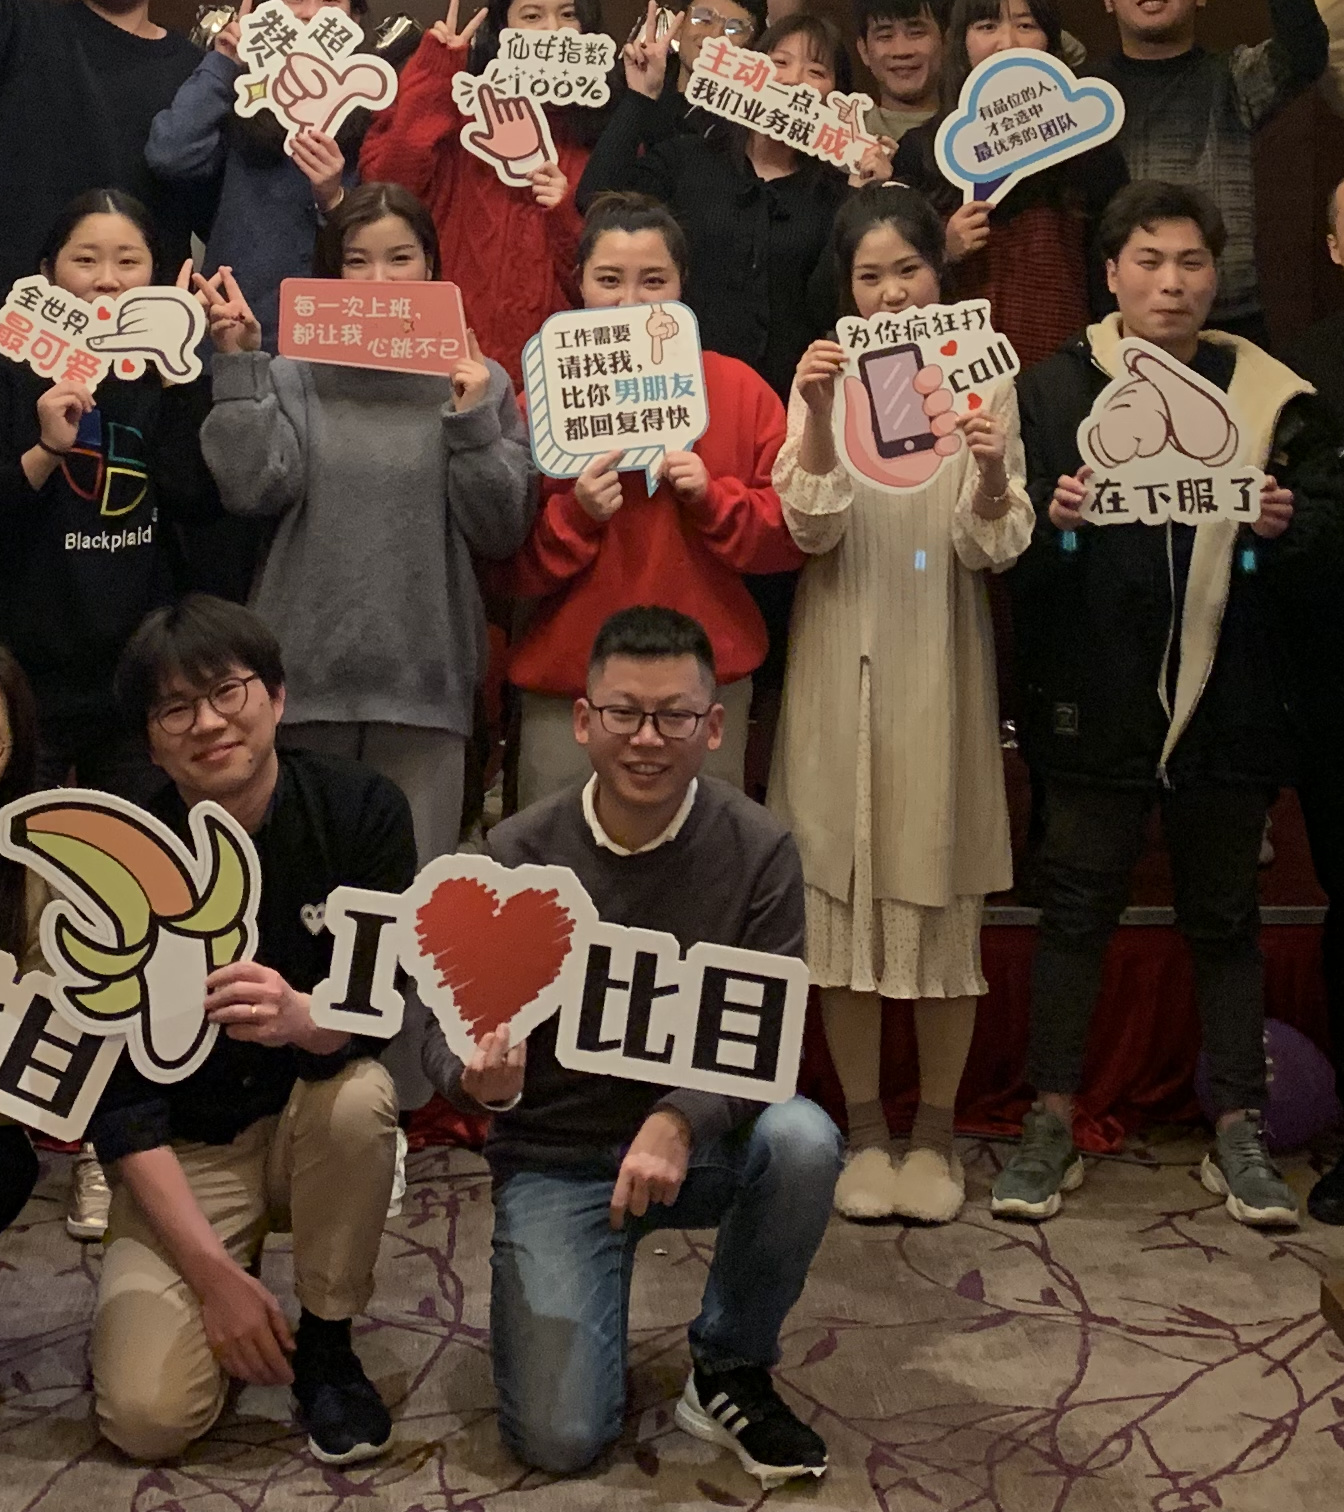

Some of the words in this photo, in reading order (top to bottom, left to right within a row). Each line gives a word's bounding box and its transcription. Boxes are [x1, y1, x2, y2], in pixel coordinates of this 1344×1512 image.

[507, 33, 609, 65] 仙女指数
[515, 73, 603, 100] 100%
[973, 112, 1078, 163] 最优秀的团队
[984, 103, 1044, 137] 才会选中
[14, 286, 89, 336] 全世界
[847, 306, 987, 349] 为你疯狂打
[292, 323, 363, 346] 都让我
[367, 337, 460, 360] 心跳不已
[554, 323, 631, 350] 工作需要
[948, 341, 1015, 393] call
[561, 372, 696, 410] 比你男朋友
[564, 404, 691, 441] 都回复得快
[1090, 477, 1256, 515] 在下服了
[64, 524, 152, 553] Blackplaid
[331, 909, 397, 1018] I
[576, 943, 790, 1082] 比目
